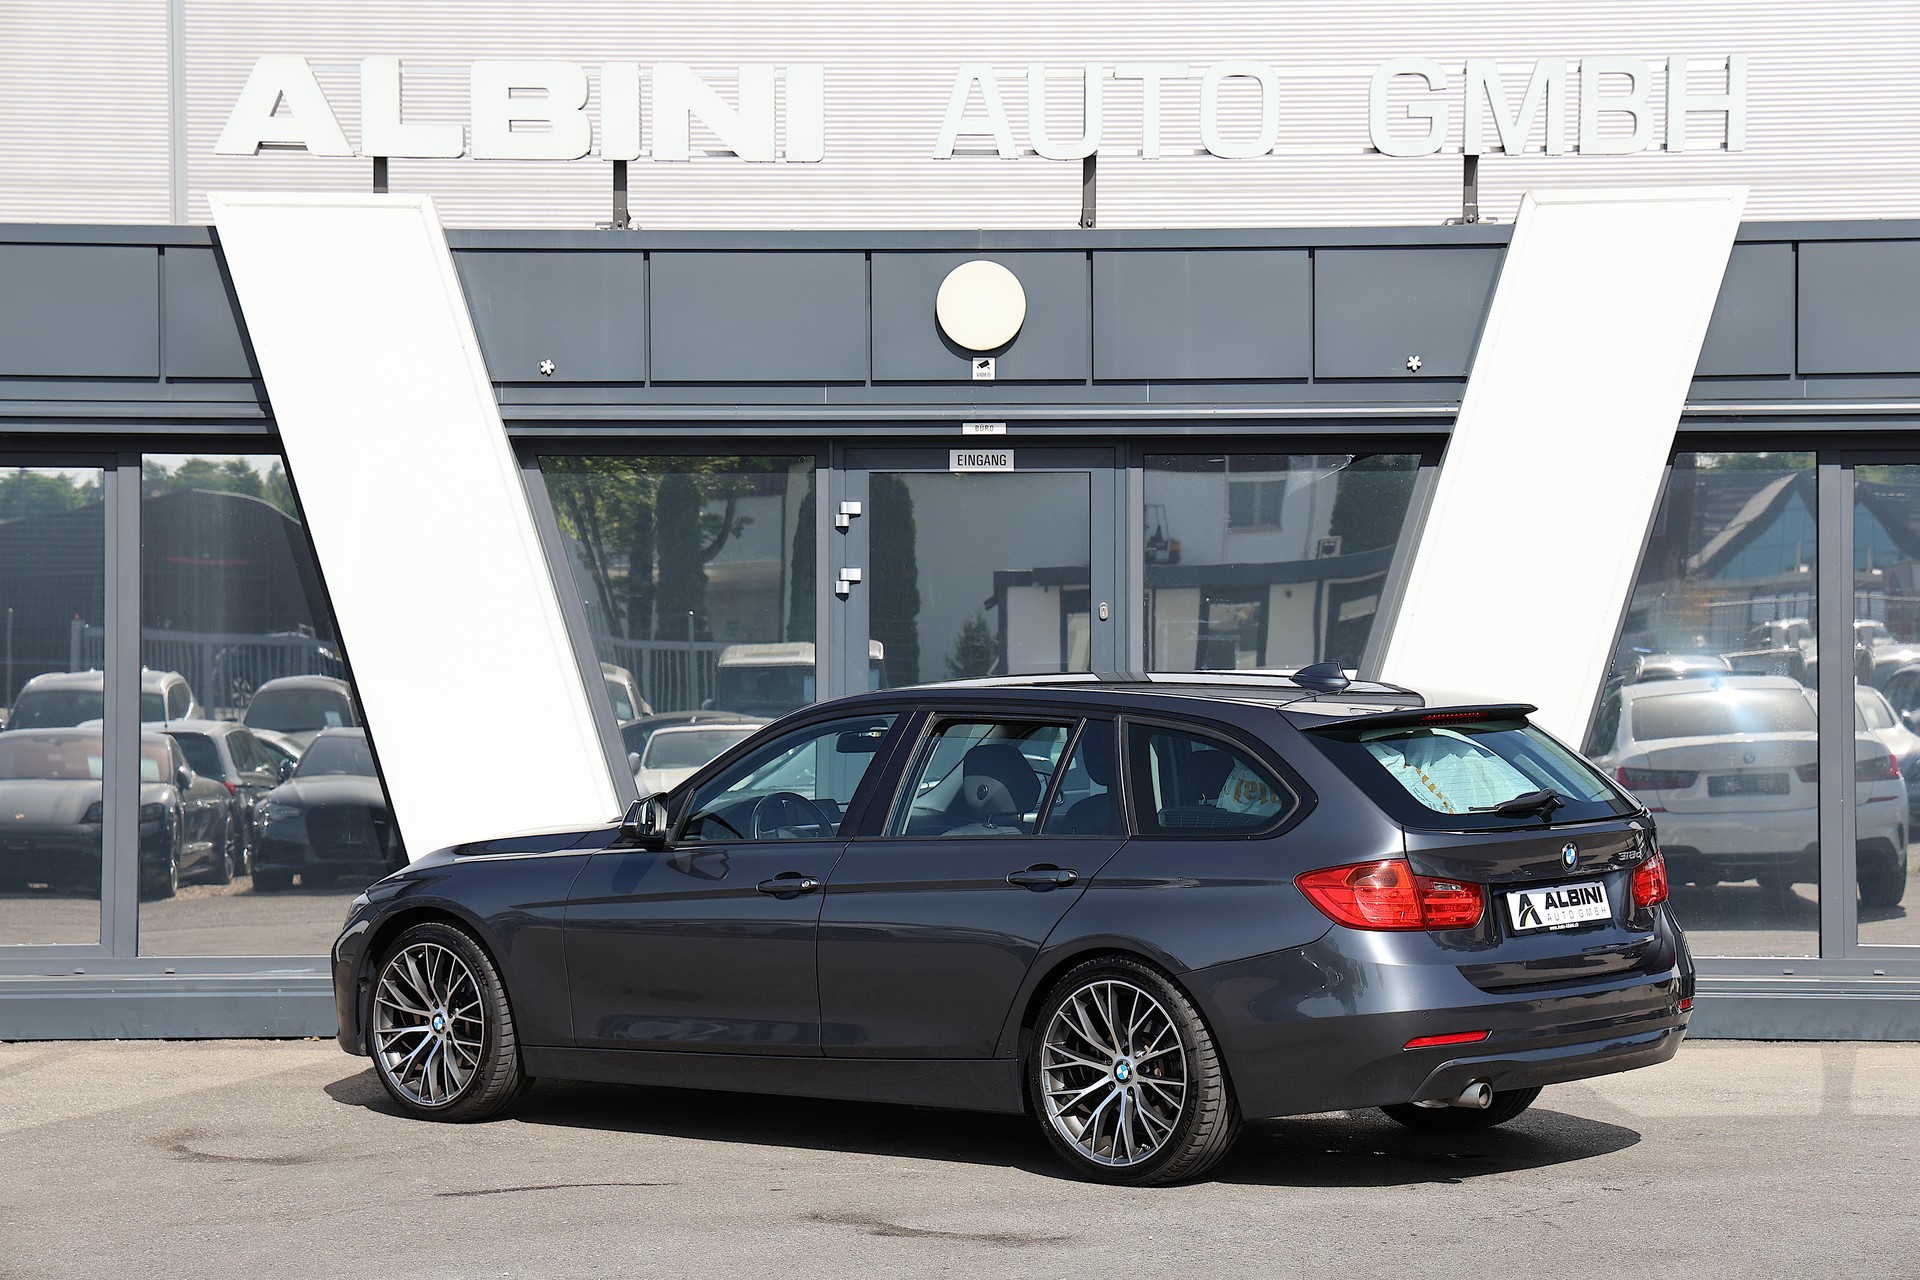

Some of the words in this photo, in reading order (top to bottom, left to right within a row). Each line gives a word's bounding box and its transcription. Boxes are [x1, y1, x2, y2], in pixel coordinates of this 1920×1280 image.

[213, 56, 825, 163] ALBINI
[933, 59, 1281, 161] AUTO
[1369, 54, 1750, 158] GMBH
[975, 424, 994, 432] BÜRO
[957, 454, 1007, 466] EINGANG
[1545, 886, 1604, 910] ALBINI
[1547, 909, 1575, 922] AUTO
[1578, 906, 1607, 918] GMBH
